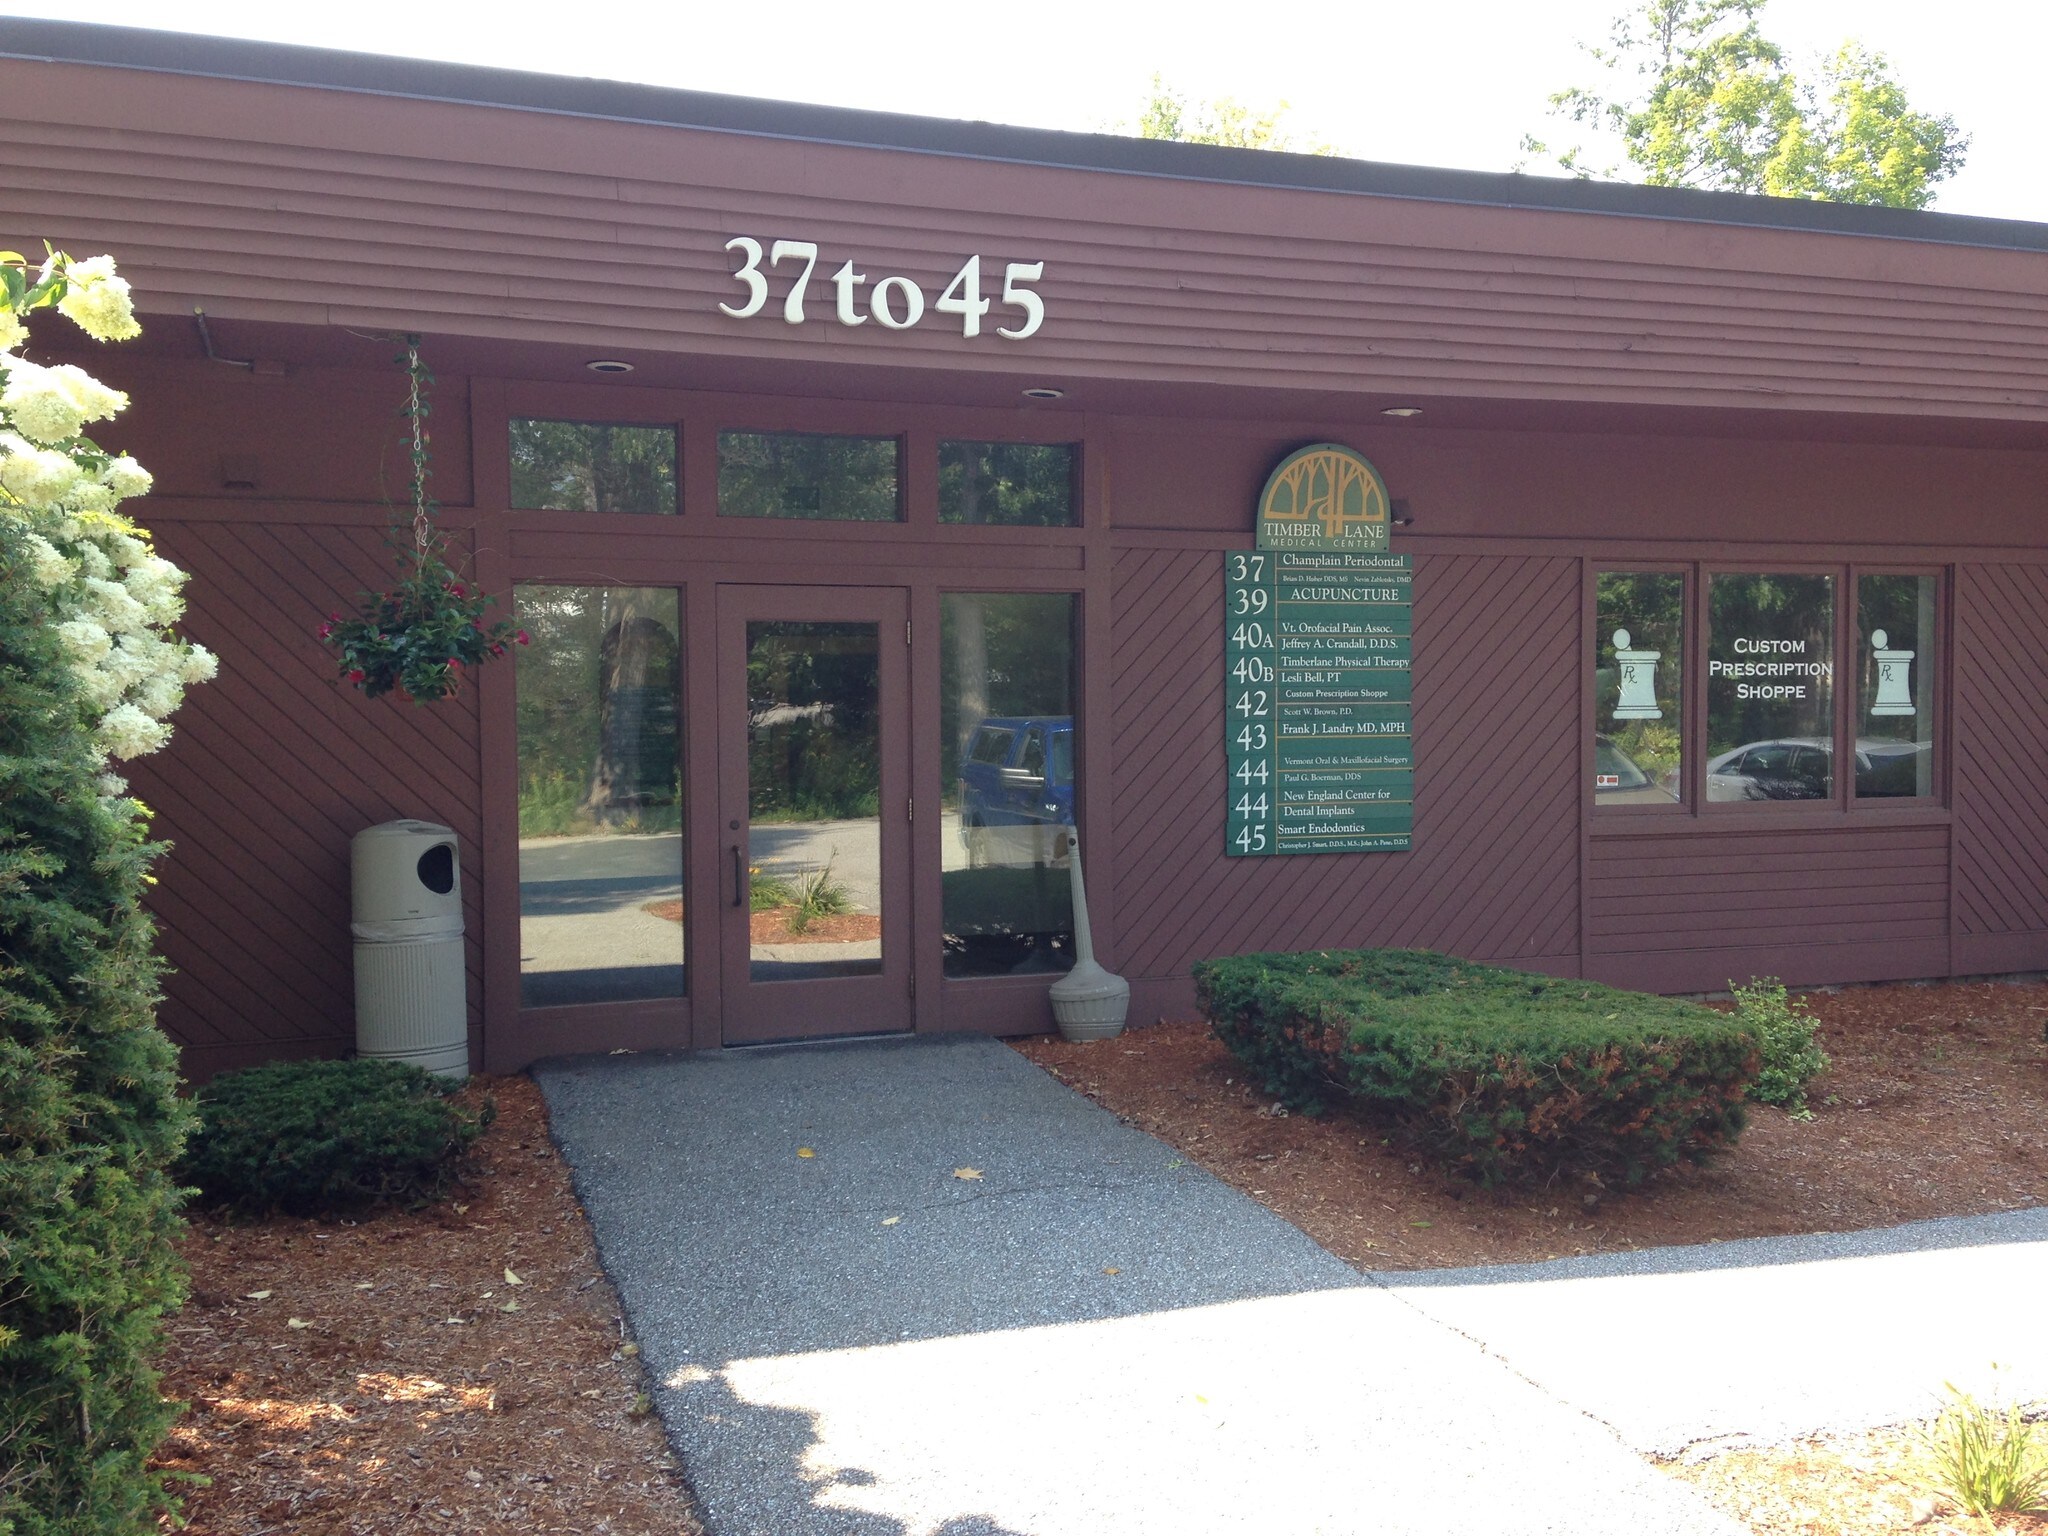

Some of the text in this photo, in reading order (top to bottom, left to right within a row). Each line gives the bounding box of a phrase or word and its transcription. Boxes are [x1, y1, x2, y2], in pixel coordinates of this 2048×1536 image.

[717, 237, 1045, 340] 37 to 45
[1264, 522, 1384, 538] TIMBER LANE
[1333, 540, 1376, 548] CENTER
[1283, 554, 1404, 568] Champlain Periodontal
[1232, 555, 1265, 582] 37
[1291, 588, 1399, 601] ACUPUNCTURE
[1234, 589, 1268, 614] 39
[1282, 623, 1393, 633] Vt. Orofacial Pain Assoc.
[1282, 639, 1398, 650] Jeffrey A. Crandall, D.D.S.
[1281, 656, 1410, 668] Timberlane Physical Therapy
[1282, 673, 1341, 683] Lesli Bell, PT
[1286, 689, 1388, 698] Custom Prescription Shoppe
[1235, 690, 1269, 718] 42
[1284, 708, 1301, 716] Scott
[1314, 708, 1338, 716] Brown,
[1283, 723, 1405, 735] Frank J. Landry MD, MPH
[1237, 724, 1267, 751] 43
[1285, 757, 1313, 765] Vermont
[1341, 756, 1382, 764] Maxillofacial
[1384, 756, 1408, 765] Surgery
[1236, 759, 1269, 786] 44
[1285, 774, 1299, 782] Paul
[1311, 774, 1343, 782] Boerman,
[1284, 789, 1391, 802] New England Center for
[1235, 792, 1269, 819] 44
[1284, 806, 1355, 817] Dental Implants
[1278, 824, 1365, 834] Smart Endodontics
[1236, 824, 1266, 853] 45
